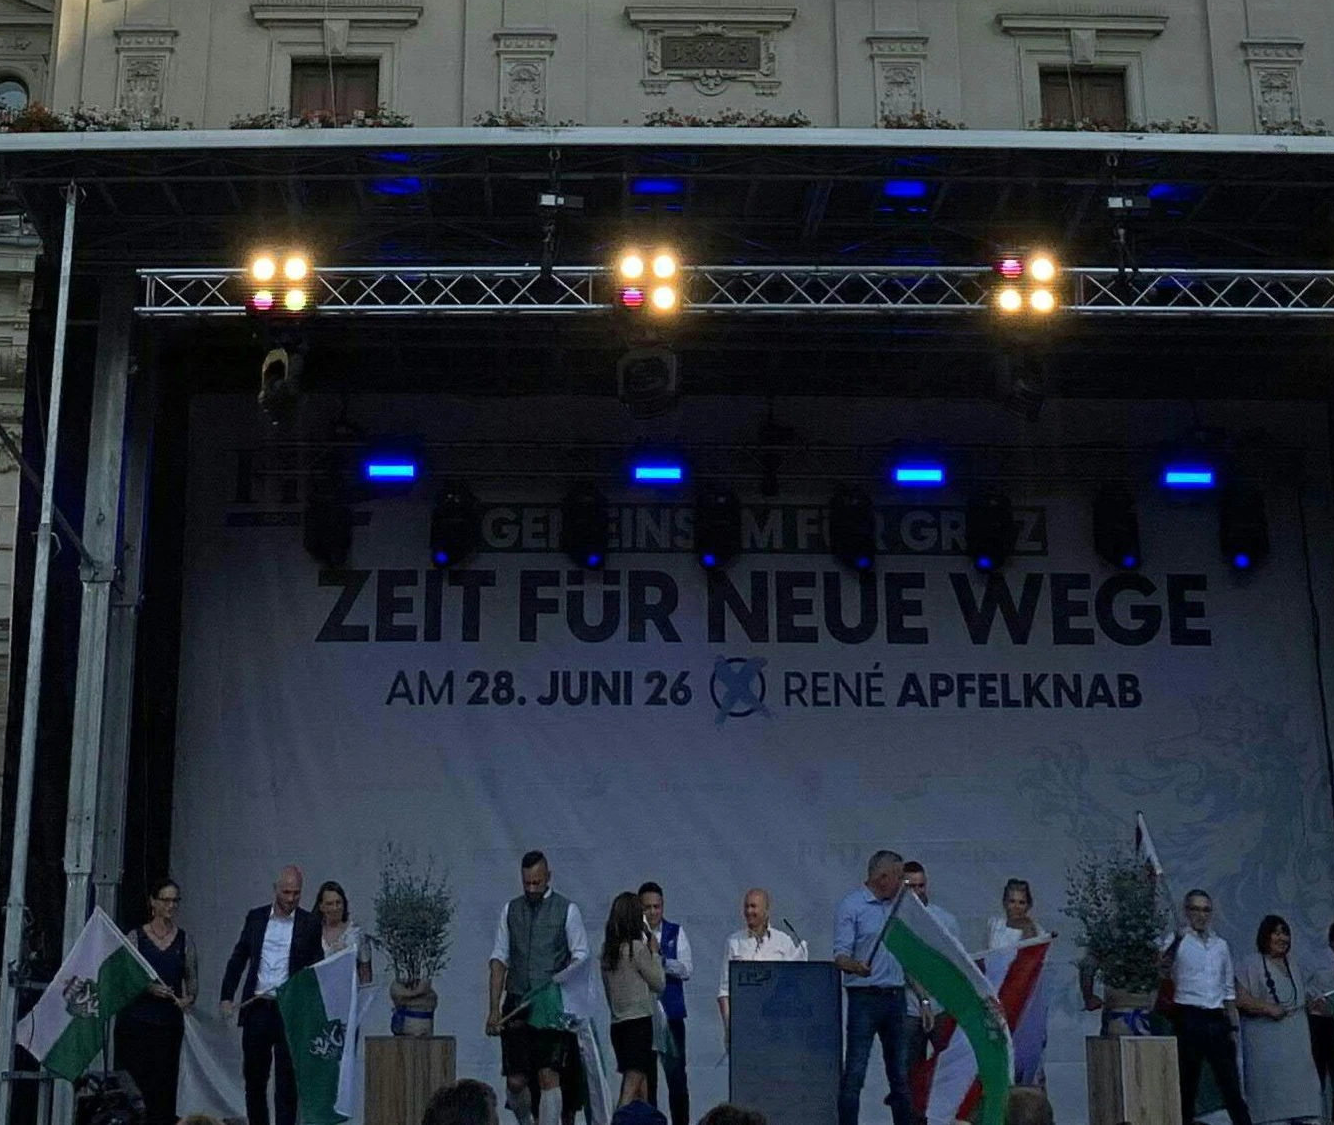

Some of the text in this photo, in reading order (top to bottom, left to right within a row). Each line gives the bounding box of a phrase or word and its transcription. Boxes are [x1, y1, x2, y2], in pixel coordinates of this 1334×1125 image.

[899, 509, 1045, 551] GRZ
[315, 569, 1213, 647] ZEIT FÜR NEUE WEGE
[386, 662, 1143, 709] AM 28. JUNI 26 RENÉ APFELKNAB
